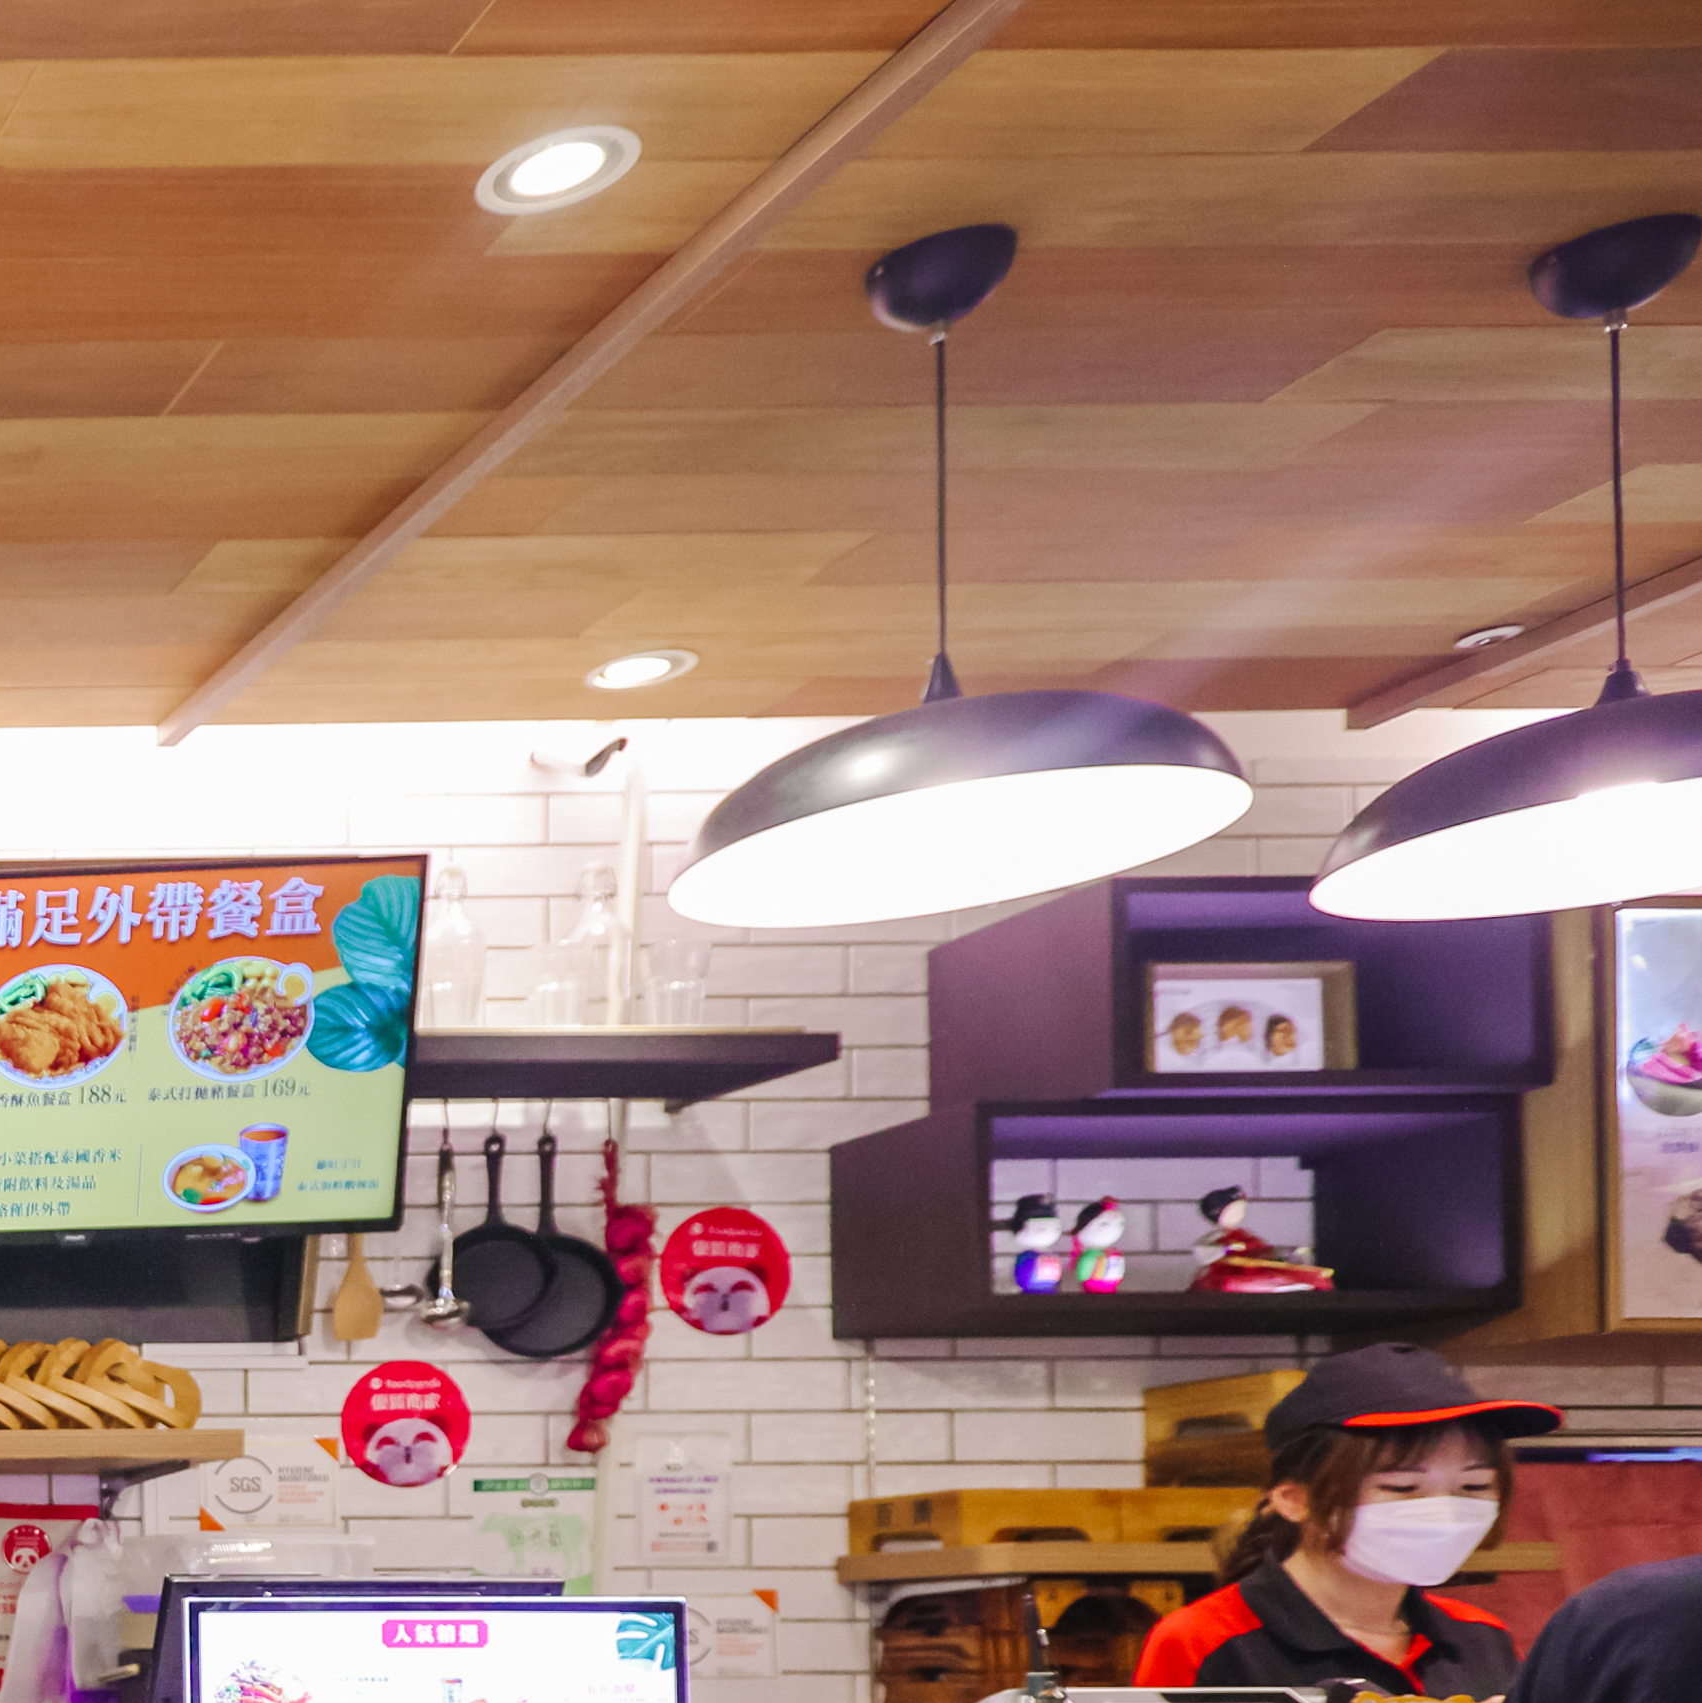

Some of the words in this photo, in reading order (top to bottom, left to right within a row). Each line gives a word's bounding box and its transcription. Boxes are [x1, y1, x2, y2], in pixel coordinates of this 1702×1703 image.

[78, 1083, 128, 1105] 188元
[262, 1077, 312, 1098] 169元
[229, 1476, 262, 1493] SGS
